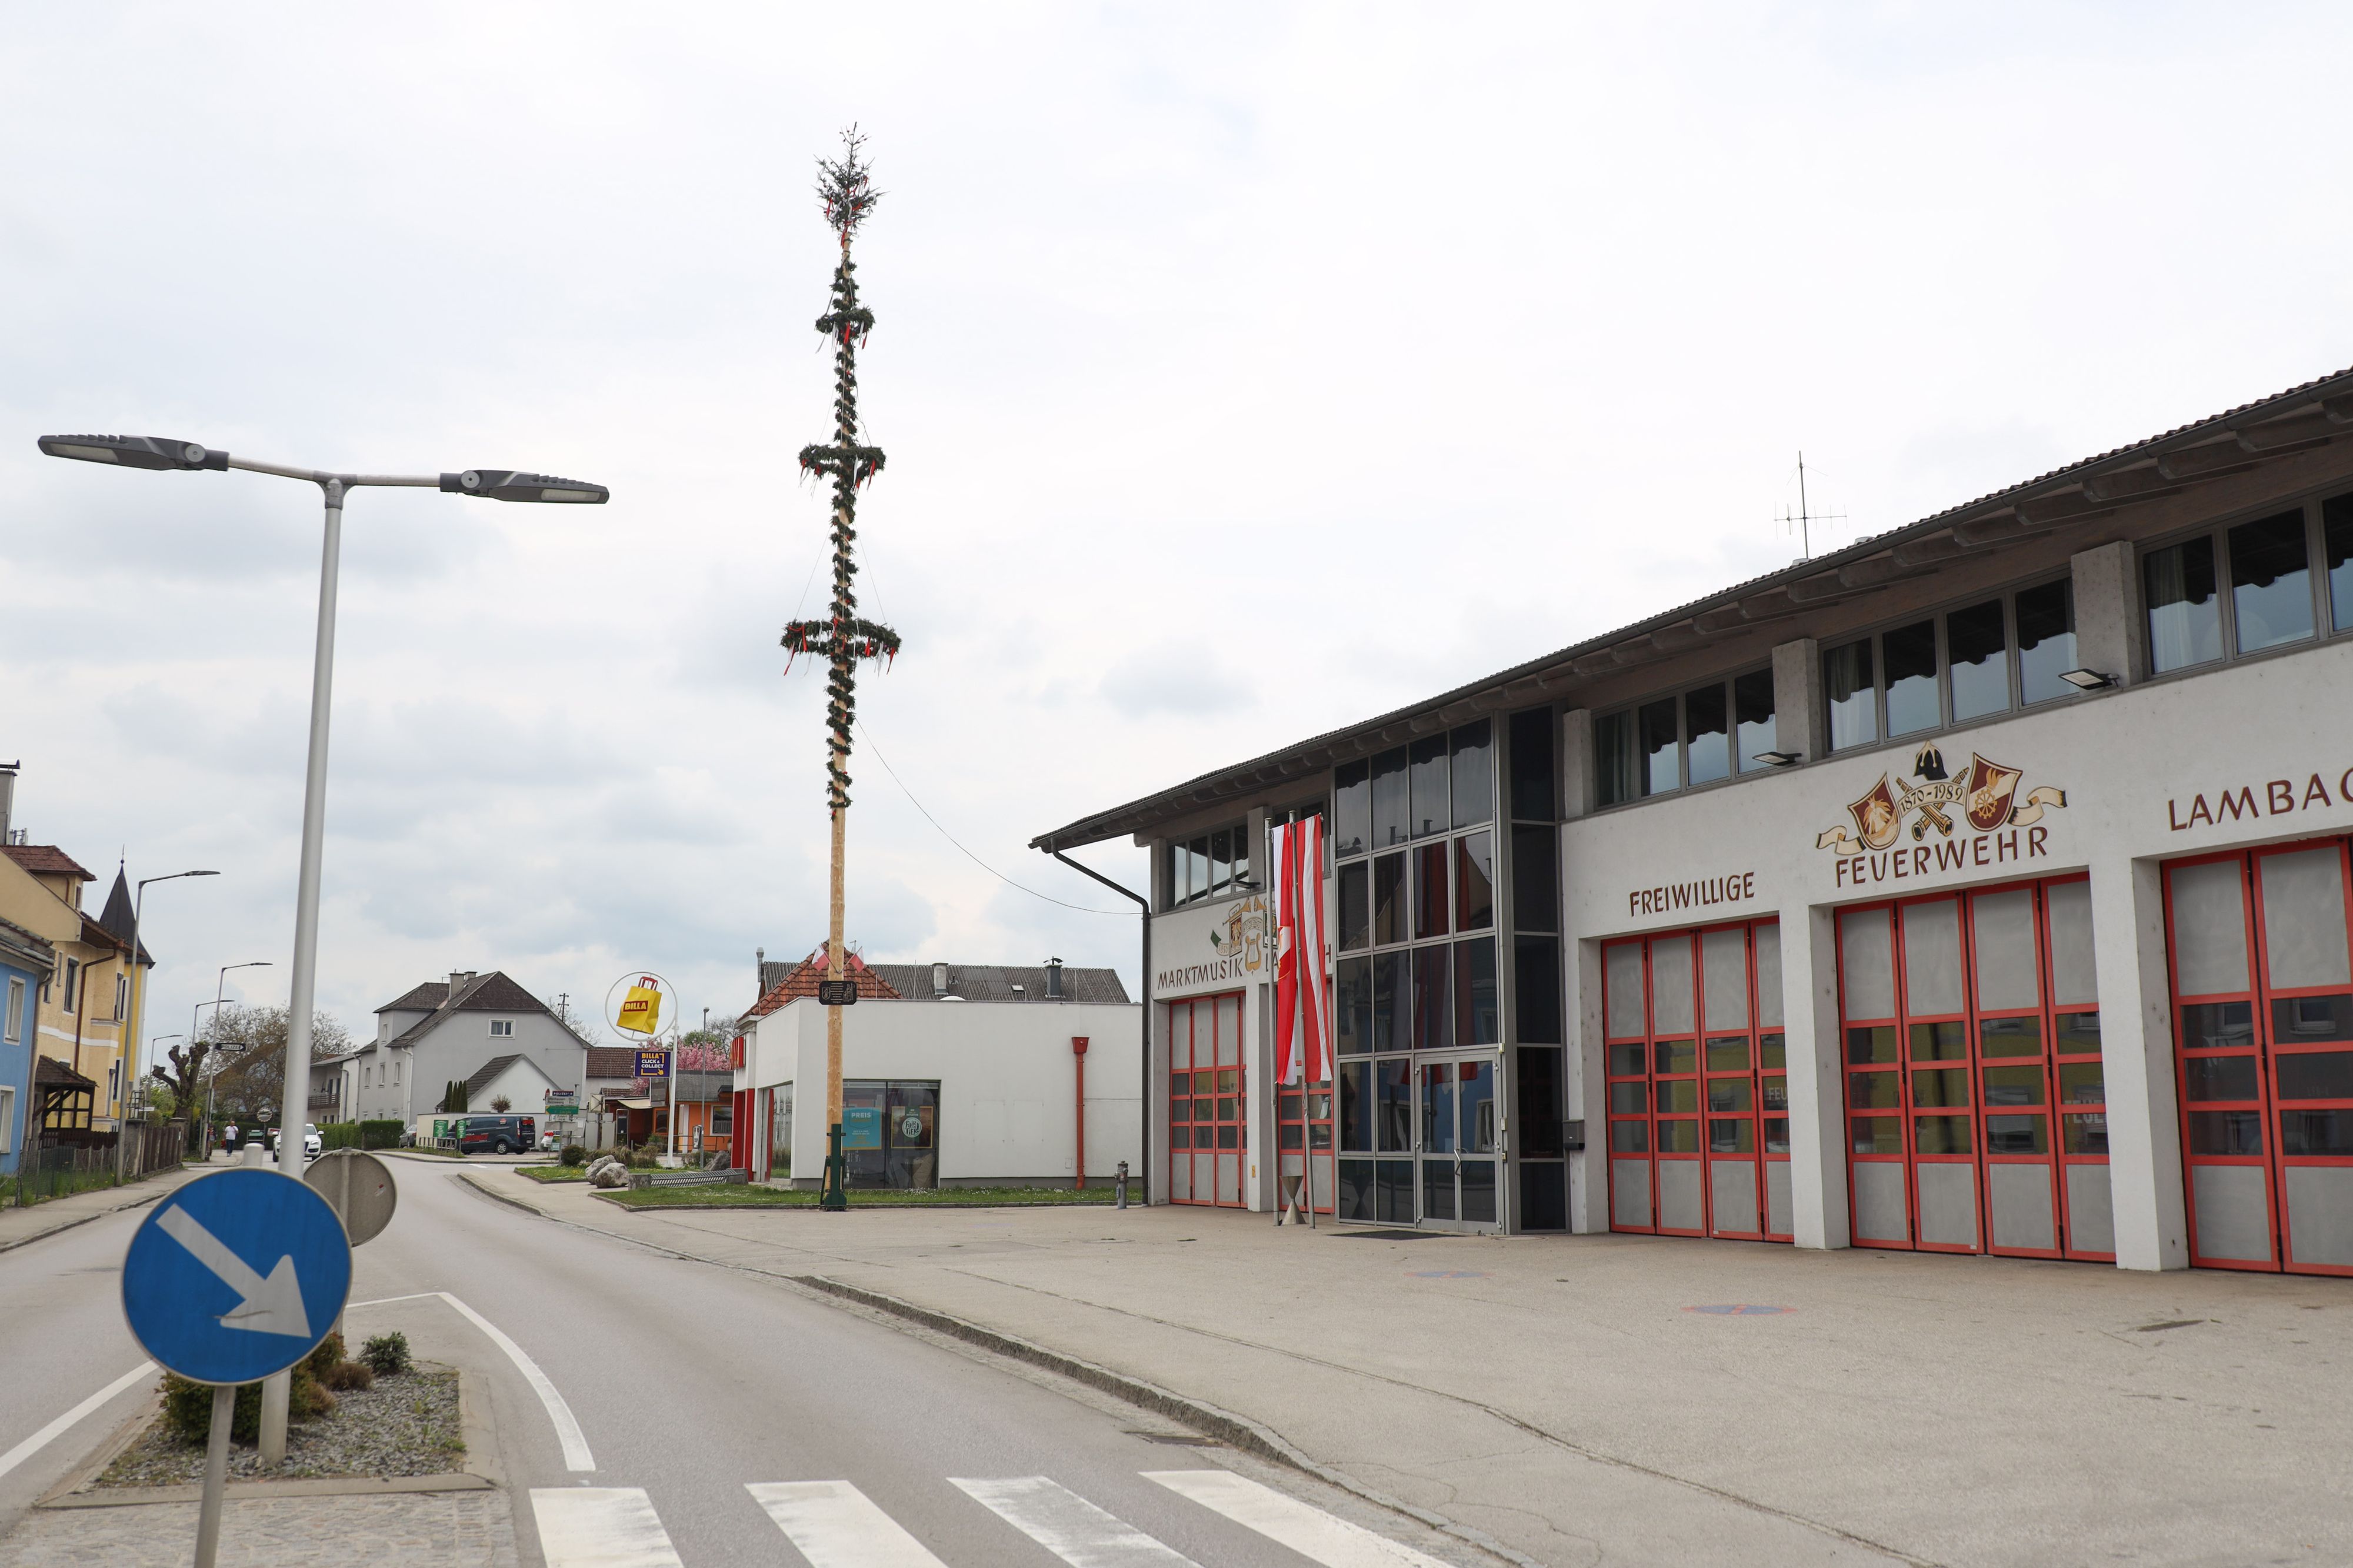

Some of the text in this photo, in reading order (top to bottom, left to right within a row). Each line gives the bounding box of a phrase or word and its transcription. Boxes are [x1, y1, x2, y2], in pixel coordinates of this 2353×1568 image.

[1836, 826, 2048, 888] FEUERWEHR
[1629, 872, 1755, 918] FREIWILLIGE
[1158, 958, 1243, 990] MARKTMUSIK
[624, 1002, 647, 1010] BILLA
